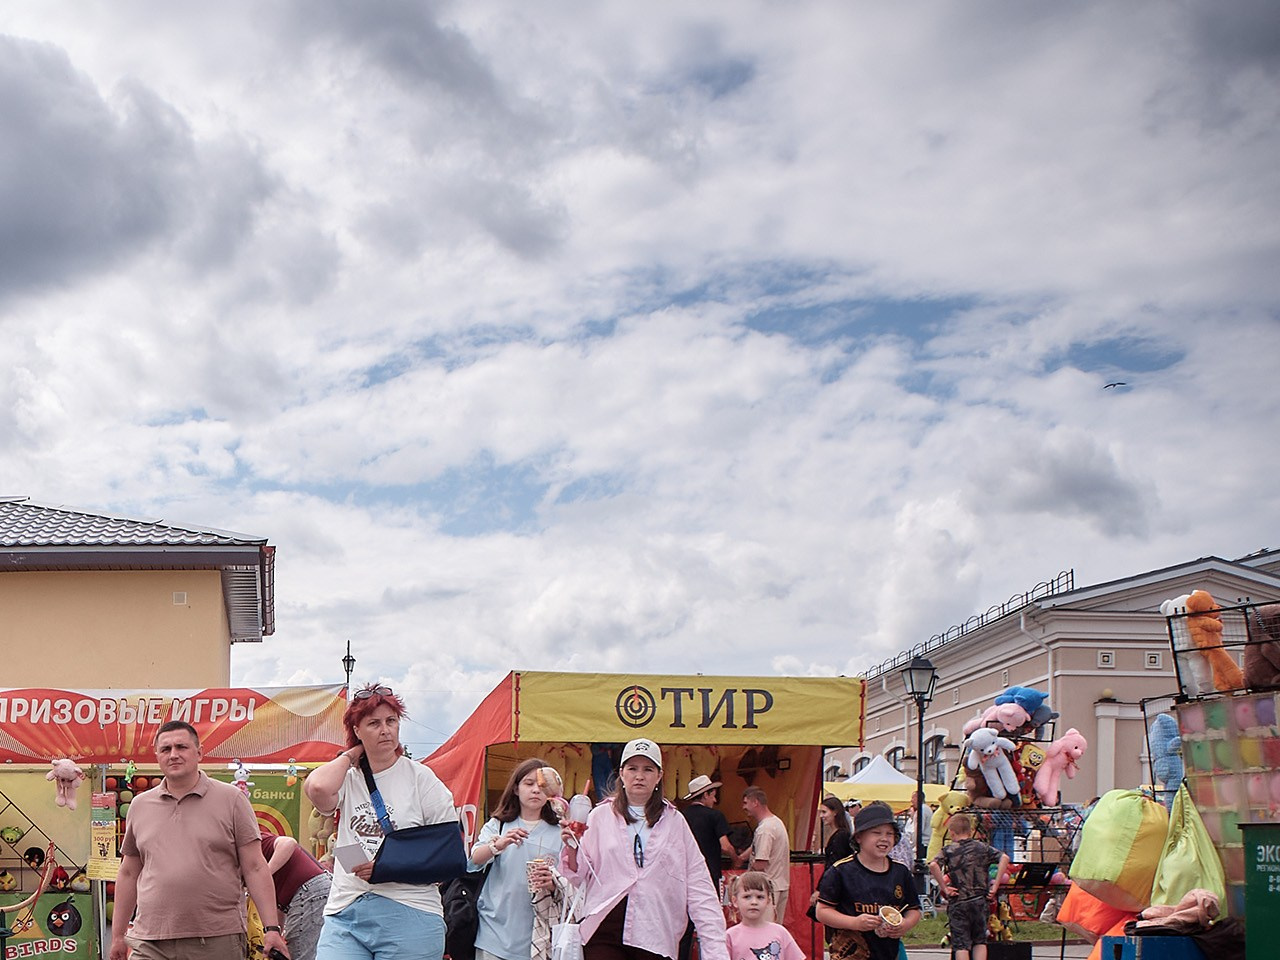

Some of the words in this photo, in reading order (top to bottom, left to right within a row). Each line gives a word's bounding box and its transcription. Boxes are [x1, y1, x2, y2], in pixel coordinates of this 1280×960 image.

[171, 697, 256, 724] ИГРЫ
[660, 687, 774, 729] ТИР
[253, 788, 295, 800] банки
[5, 938, 78, 960] BIRDS
